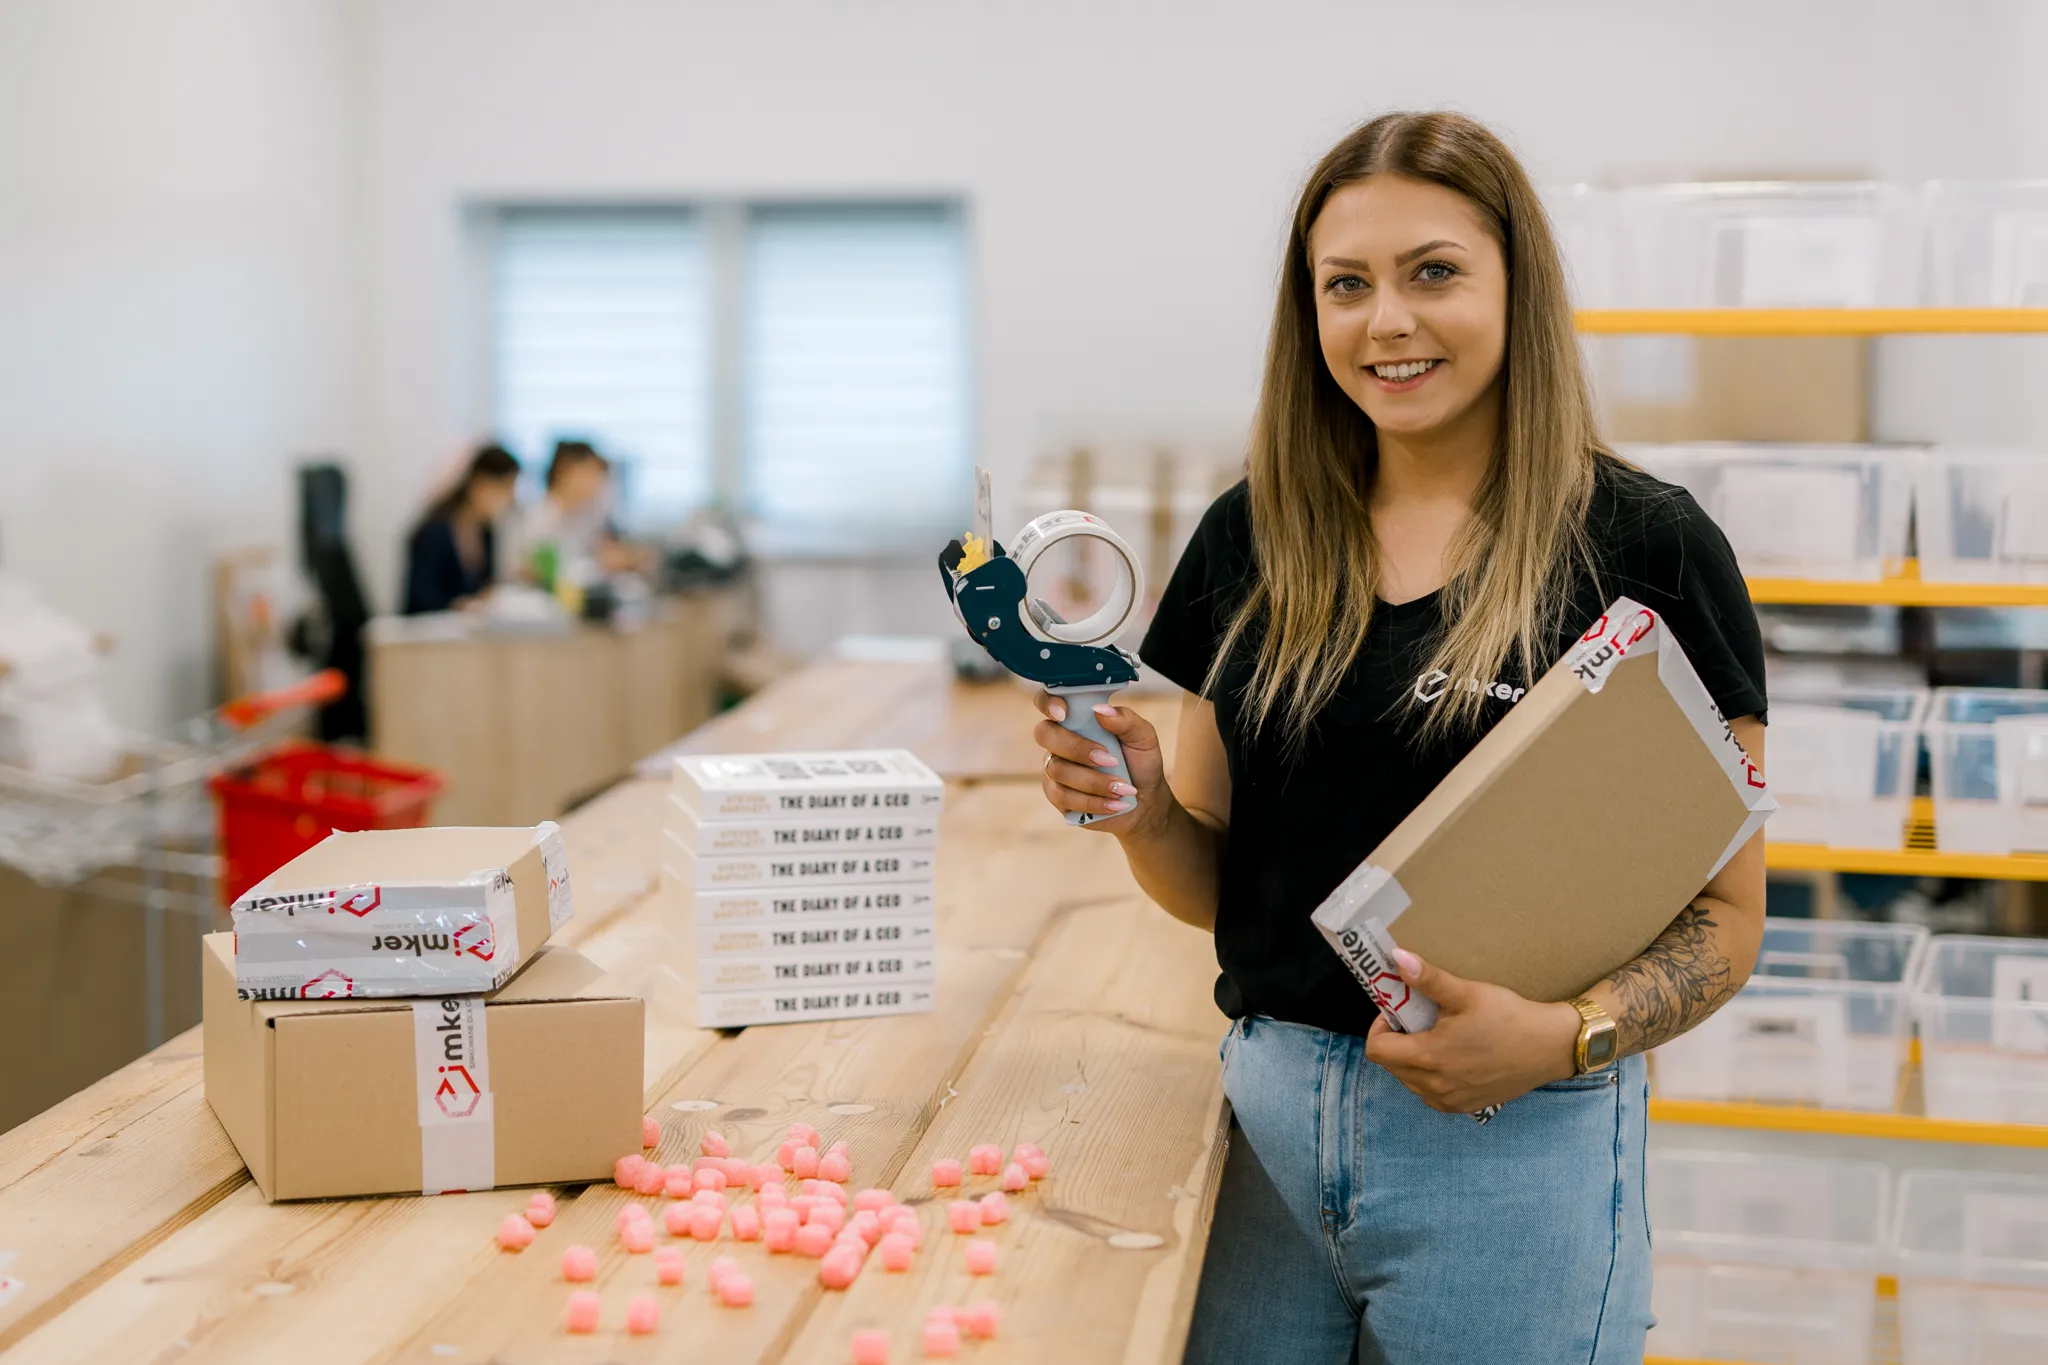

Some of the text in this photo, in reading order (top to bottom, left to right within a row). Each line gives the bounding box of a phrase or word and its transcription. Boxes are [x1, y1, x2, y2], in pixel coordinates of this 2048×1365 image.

[780, 793, 910, 809] THE DIARY OF A CEO
[774, 826, 903, 843] THE DIARY OF A CEO
[771, 858, 900, 876] THE DIARY OF A CEO
[773, 894, 900, 913] THE DIARY OF A CEO
[773, 926, 900, 945] THE DIARY OF A CEO
[775, 959, 902, 978] THE DIARY OF A CEO
[775, 992, 900, 1011] THE DIARY OF A CEO
